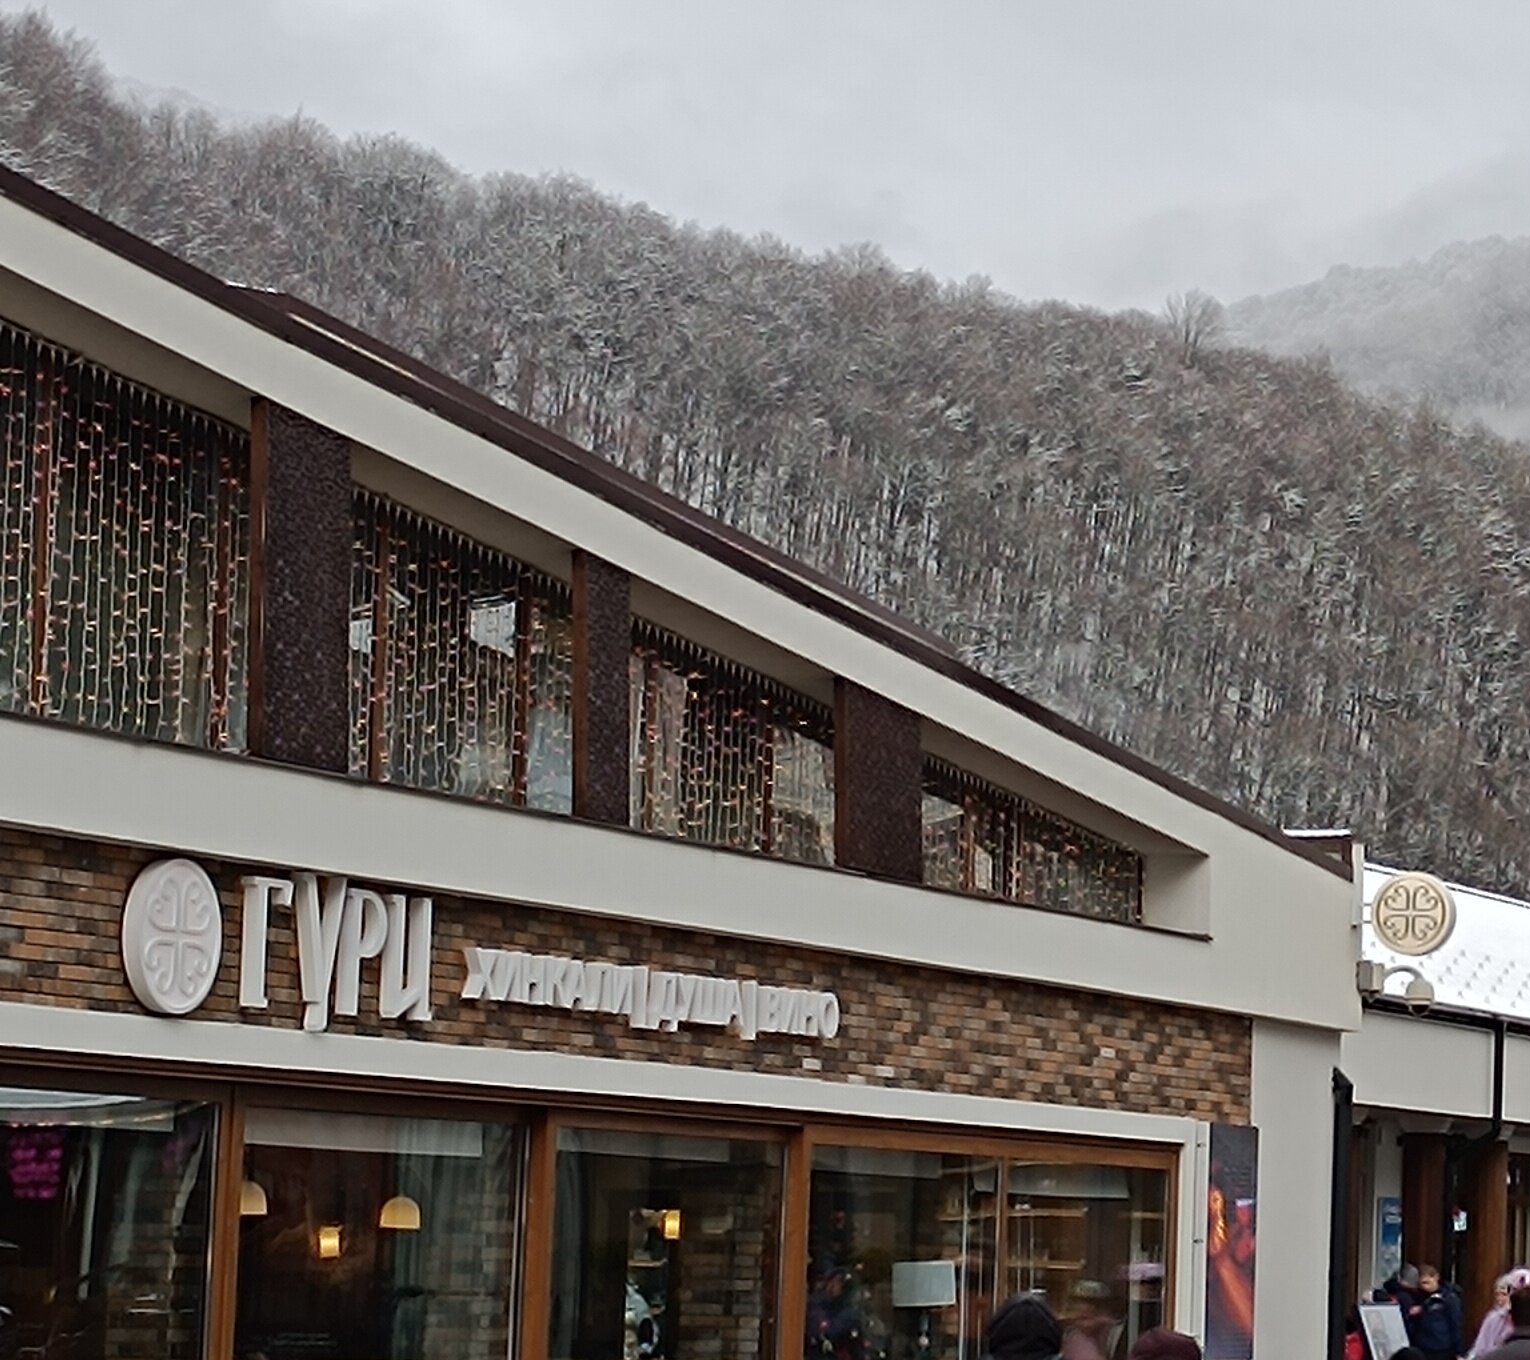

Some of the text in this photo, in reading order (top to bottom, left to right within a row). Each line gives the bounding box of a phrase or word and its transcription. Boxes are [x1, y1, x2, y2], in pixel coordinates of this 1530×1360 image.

[239, 871, 433, 1032] ГУРИ
[461, 947, 840, 1040] ХИНКАЛИ ДУША ВИНО
